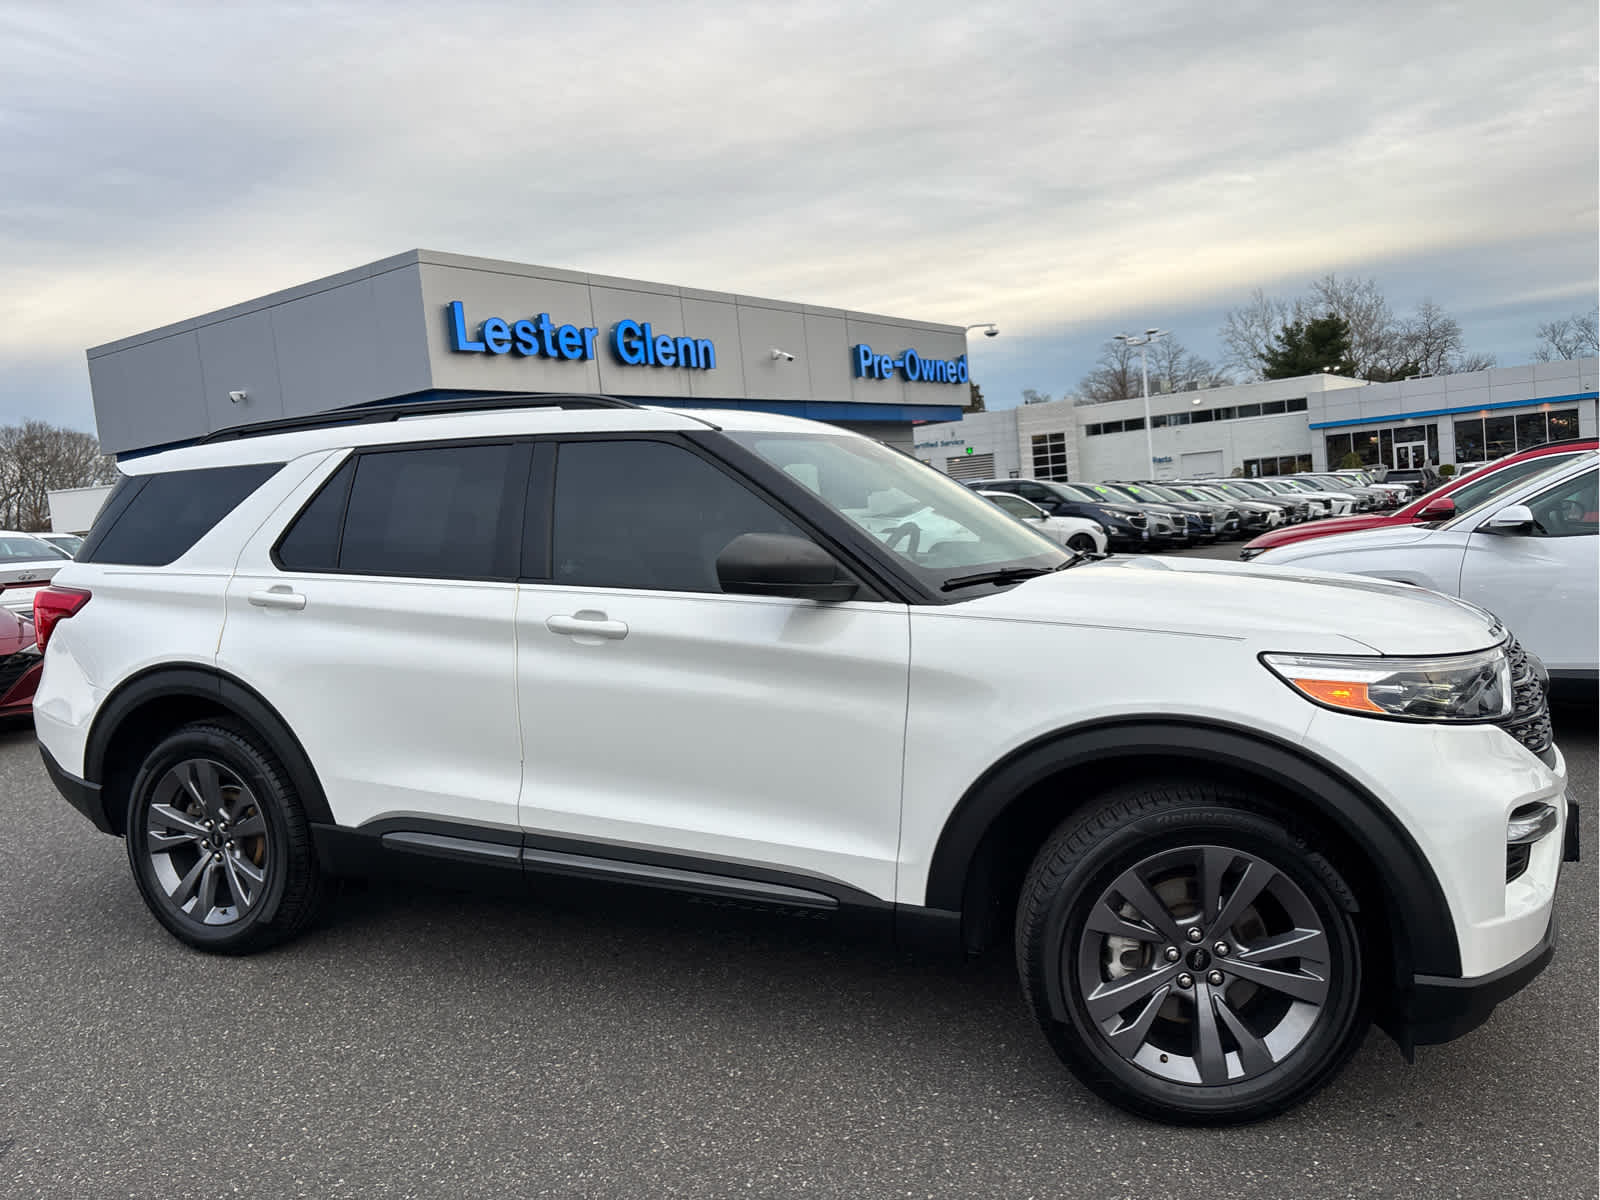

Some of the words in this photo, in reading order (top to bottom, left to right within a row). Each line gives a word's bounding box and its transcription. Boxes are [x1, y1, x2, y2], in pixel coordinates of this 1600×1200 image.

[447, 300, 598, 360] Lester
[609, 319, 717, 369] Glenn
[852, 344, 969, 384] Pre-Owned
[914, 440, 938, 449] ertified
